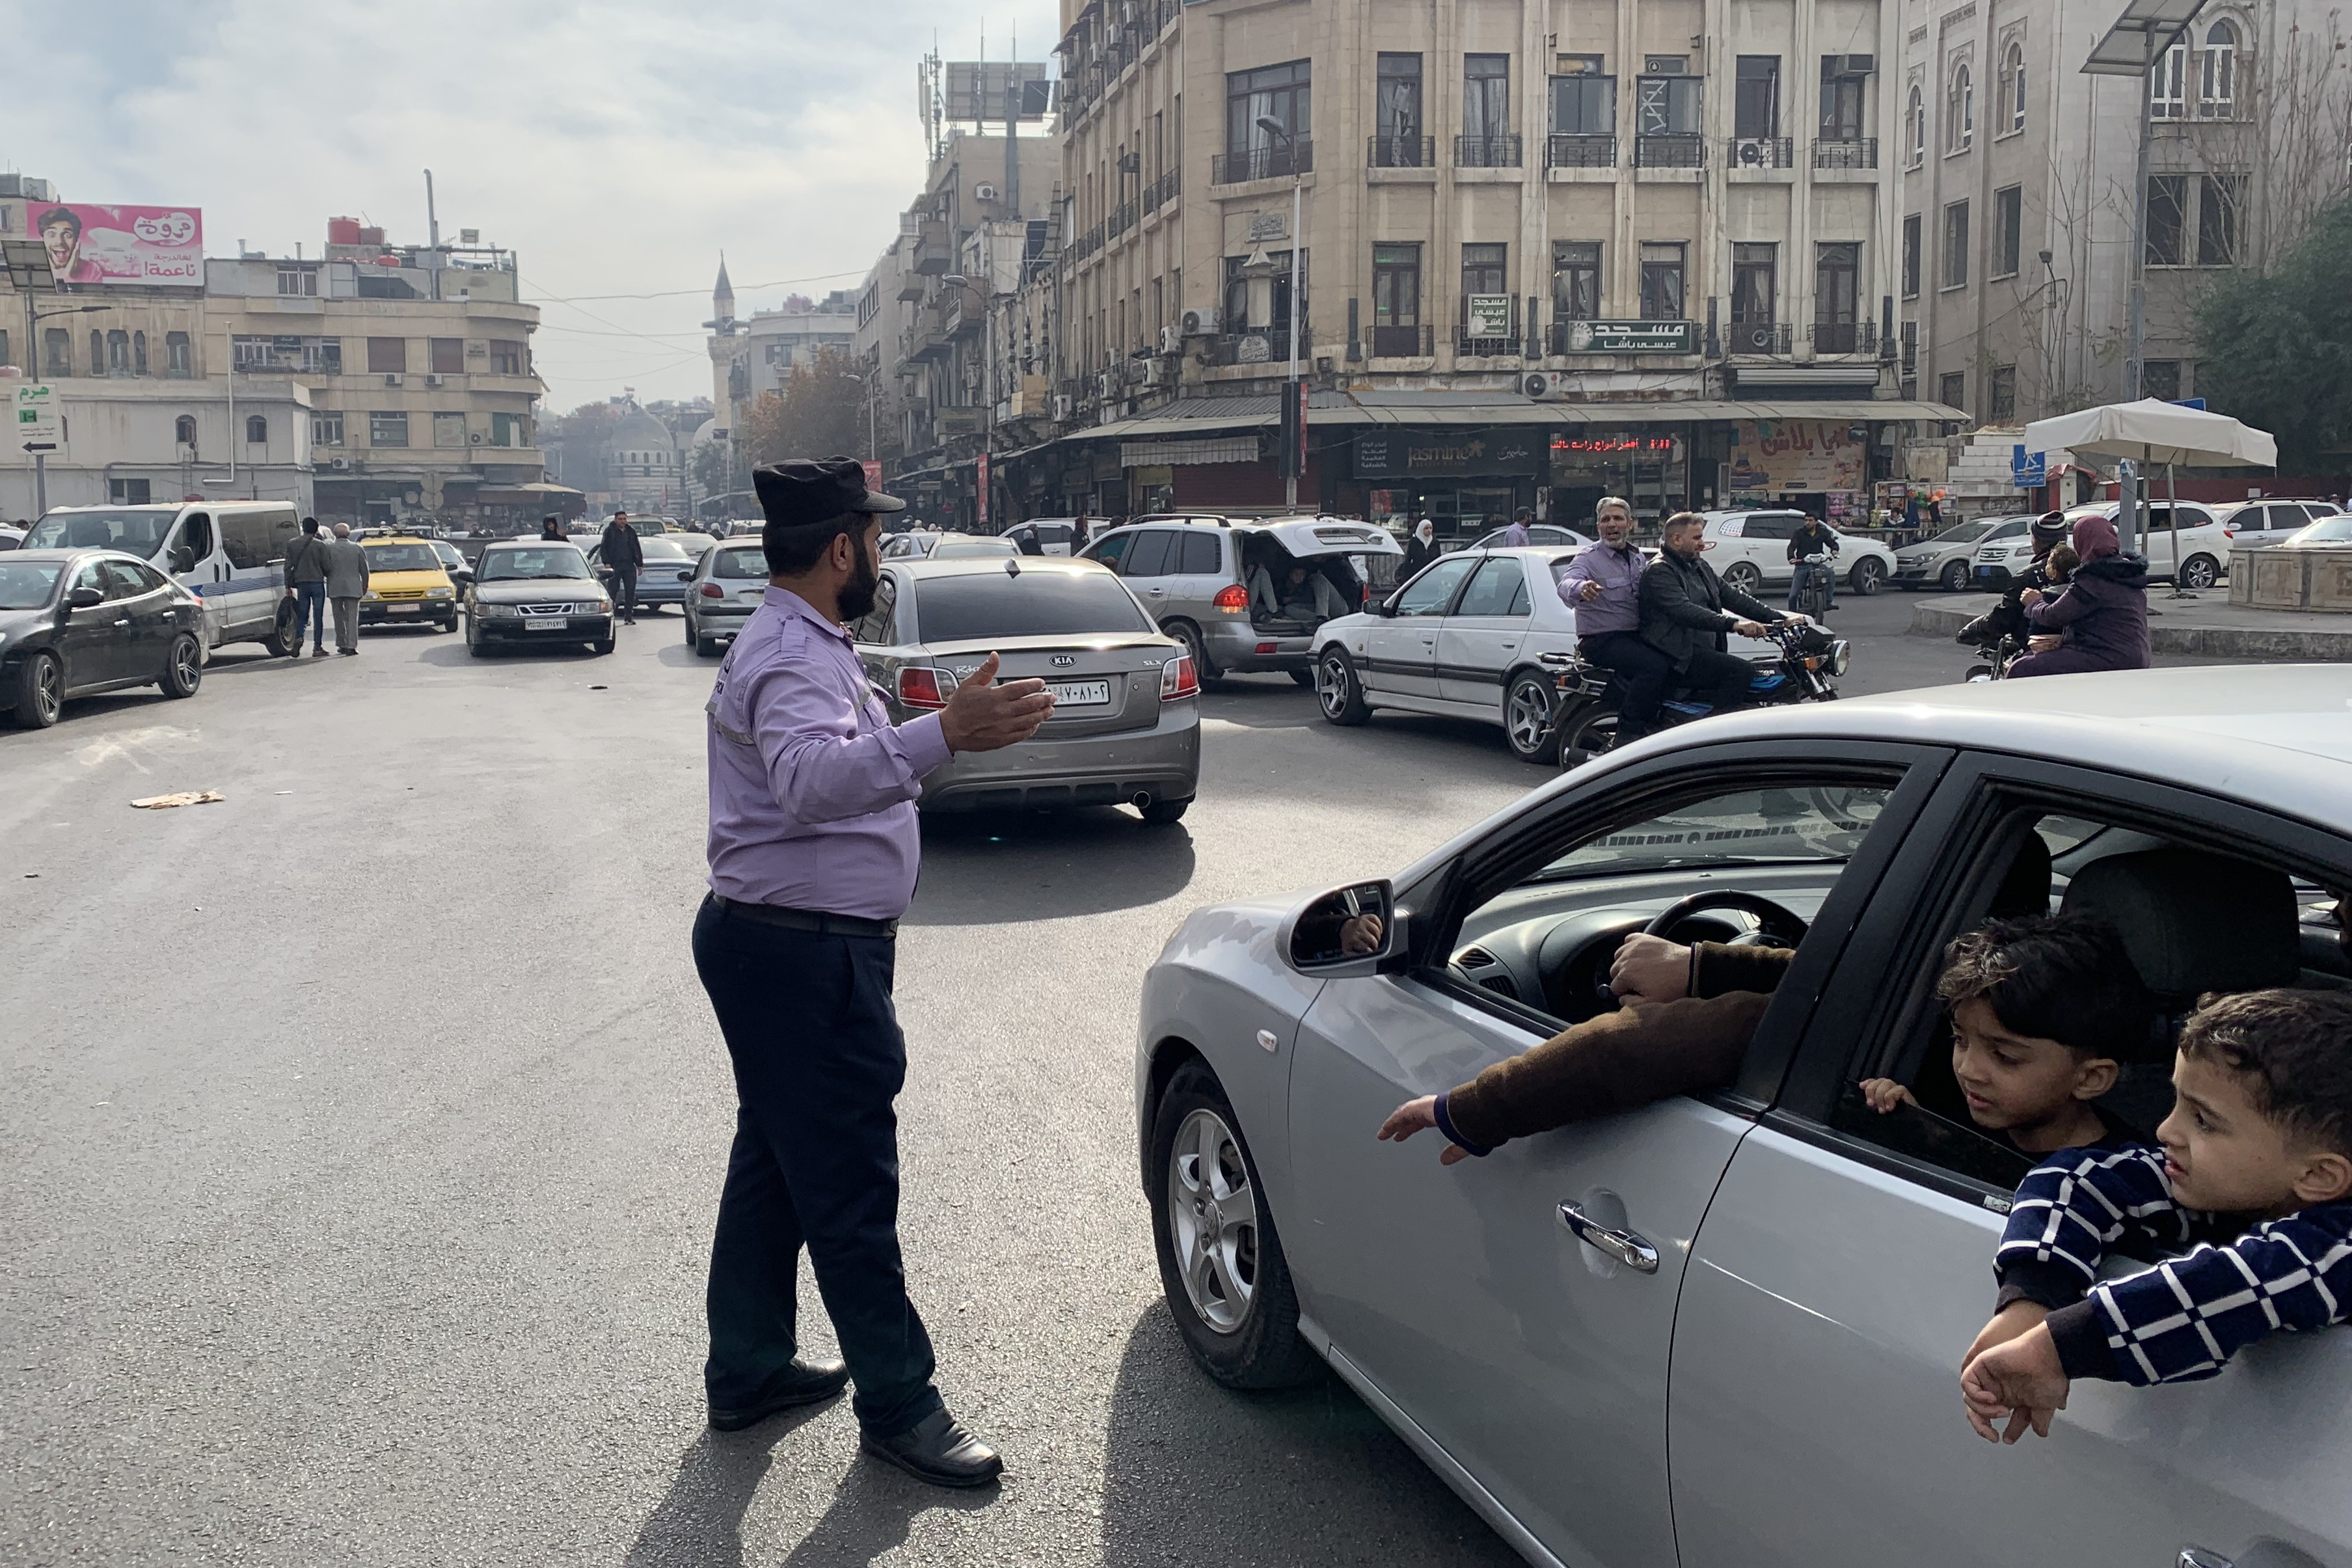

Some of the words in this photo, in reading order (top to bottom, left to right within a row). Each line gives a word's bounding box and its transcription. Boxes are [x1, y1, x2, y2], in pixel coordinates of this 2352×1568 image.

[144, 261, 196, 277] ناعمة!
[1474, 299, 1507, 307] مسجد
[1595, 324, 1684, 340] مسجد
[1604, 340, 1636, 350] باشا
[1636, 340, 1677, 350] عيسى
[20, 386, 49, 401] هرم
[1761, 423, 1814, 456] بلاش
[1054, 656, 1072, 665] KIA
